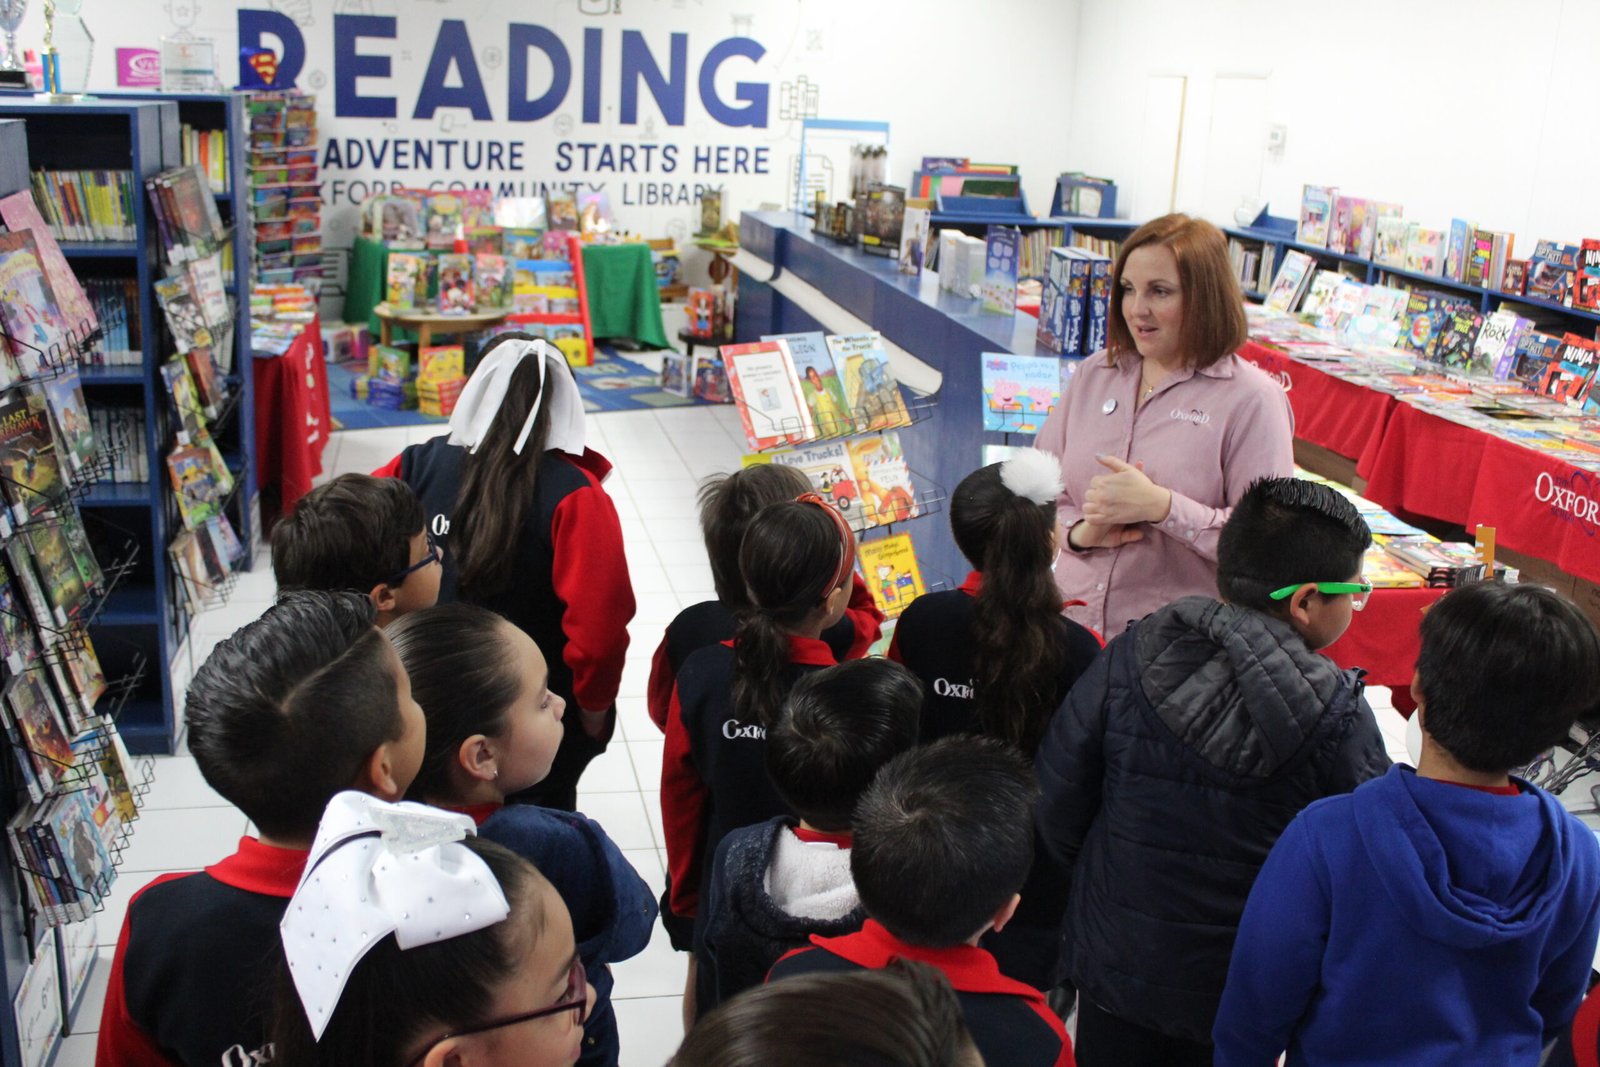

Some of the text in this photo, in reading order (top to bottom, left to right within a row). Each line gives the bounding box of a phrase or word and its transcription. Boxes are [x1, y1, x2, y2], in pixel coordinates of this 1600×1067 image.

[238, 9, 770, 129] READING
[322, 138, 770, 174] ADVENTURE STARTS HERE
[2, 408, 27, 428] LAST
[781, 455, 804, 466] Love
[804, 444, 844, 463] Trucks!
[1535, 471, 1600, 526] OXFOR
